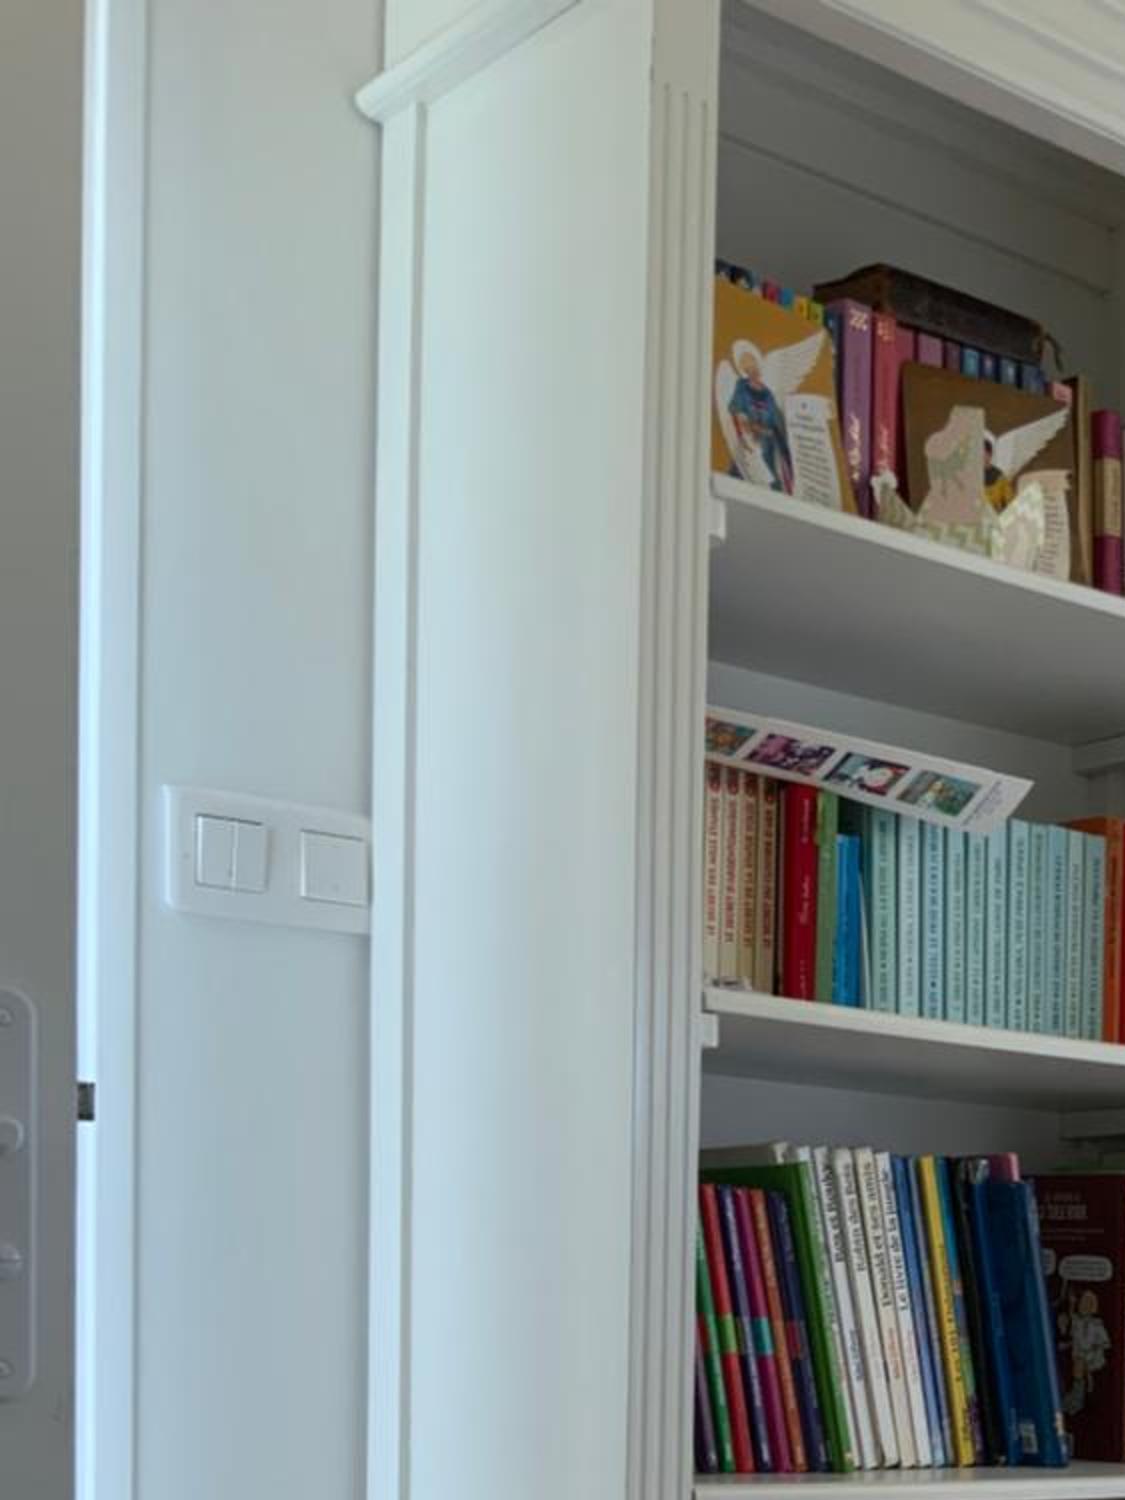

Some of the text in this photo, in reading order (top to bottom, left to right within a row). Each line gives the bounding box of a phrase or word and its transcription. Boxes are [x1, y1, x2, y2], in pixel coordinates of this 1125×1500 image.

[861, 1160, 876, 1201] amis
[880, 1168, 896, 1215] jungle
[845, 1199, 858, 1224] des
[869, 1204, 879, 1230] ses
[850, 1228, 865, 1272] Robin
[888, 1234, 899, 1253] de
[874, 1251, 891, 1307] Donald
[891, 1255, 905, 1290] livre
[896, 1292, 908, 1311] Le
